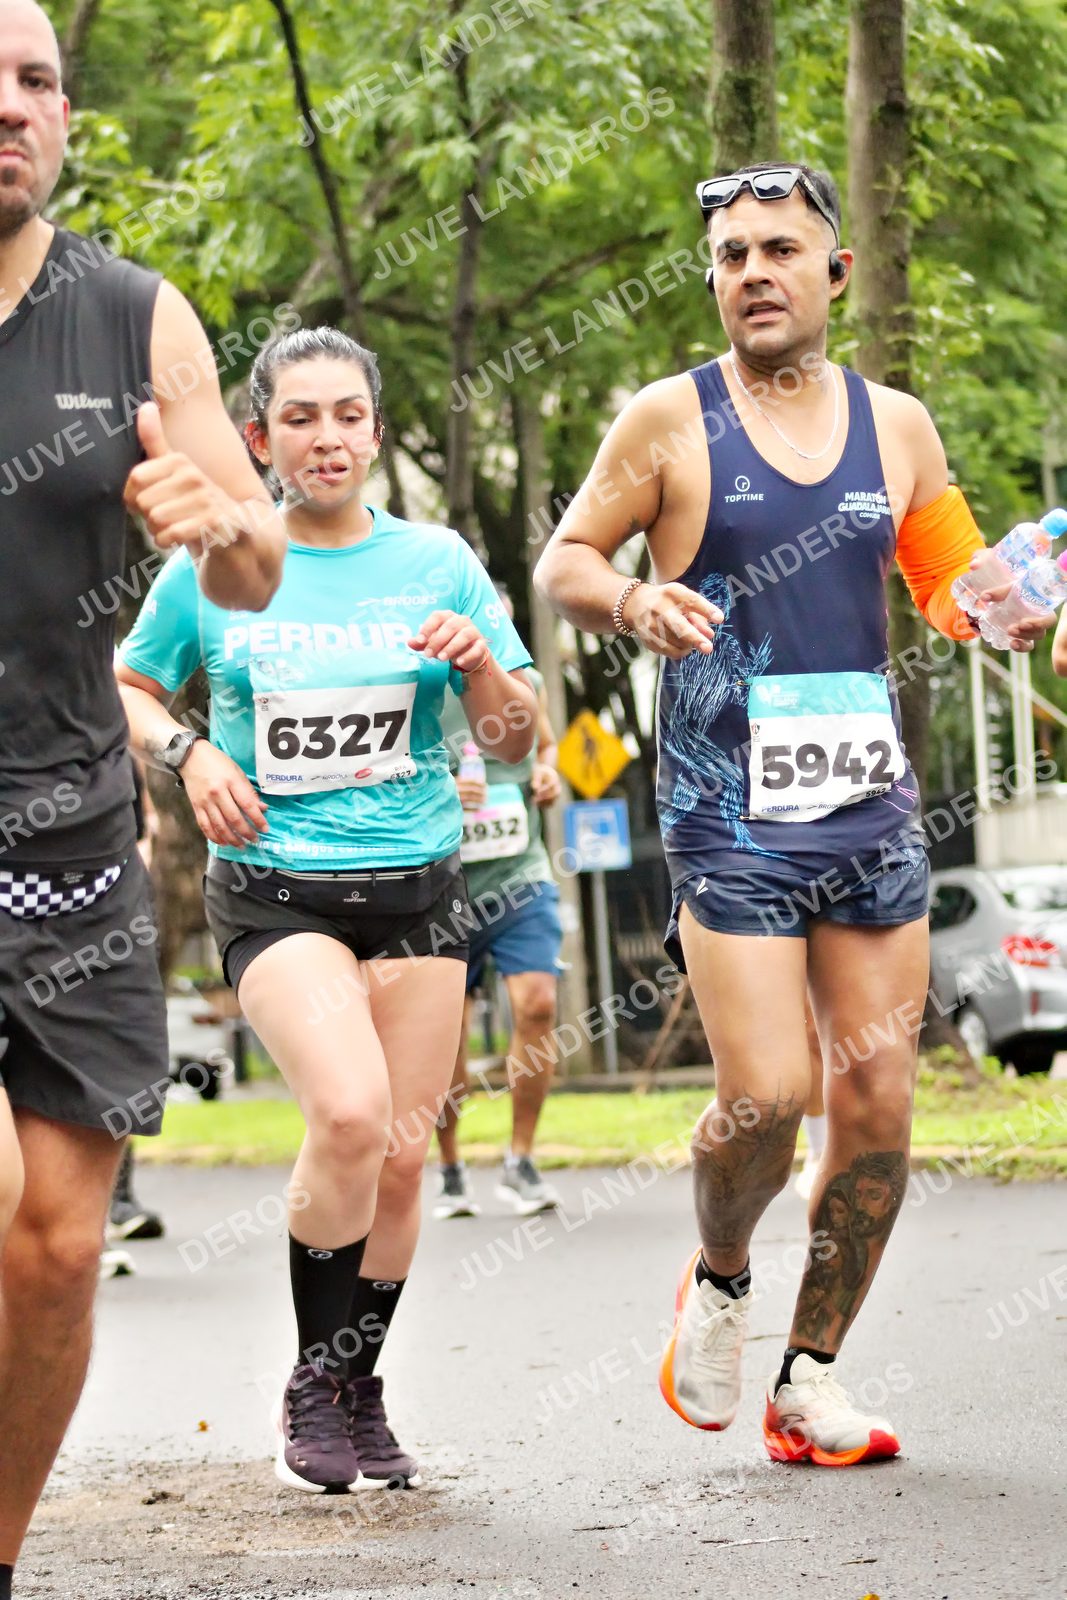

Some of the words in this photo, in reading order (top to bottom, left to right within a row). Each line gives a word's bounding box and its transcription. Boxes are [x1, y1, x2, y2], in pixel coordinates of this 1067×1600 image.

[55, 393, 113, 410] Wilson
[725, 493, 764, 503] TOPTIME
[383, 594, 437, 606] BROOKS
[223, 620, 425, 660] PERDUR
[268, 709, 407, 760] 6327
[761, 740, 895, 790] 5942
[265, 773, 304, 782] PERDURA
[866, 787, 888, 798] 5942
[762, 804, 800, 812] PERDURA
